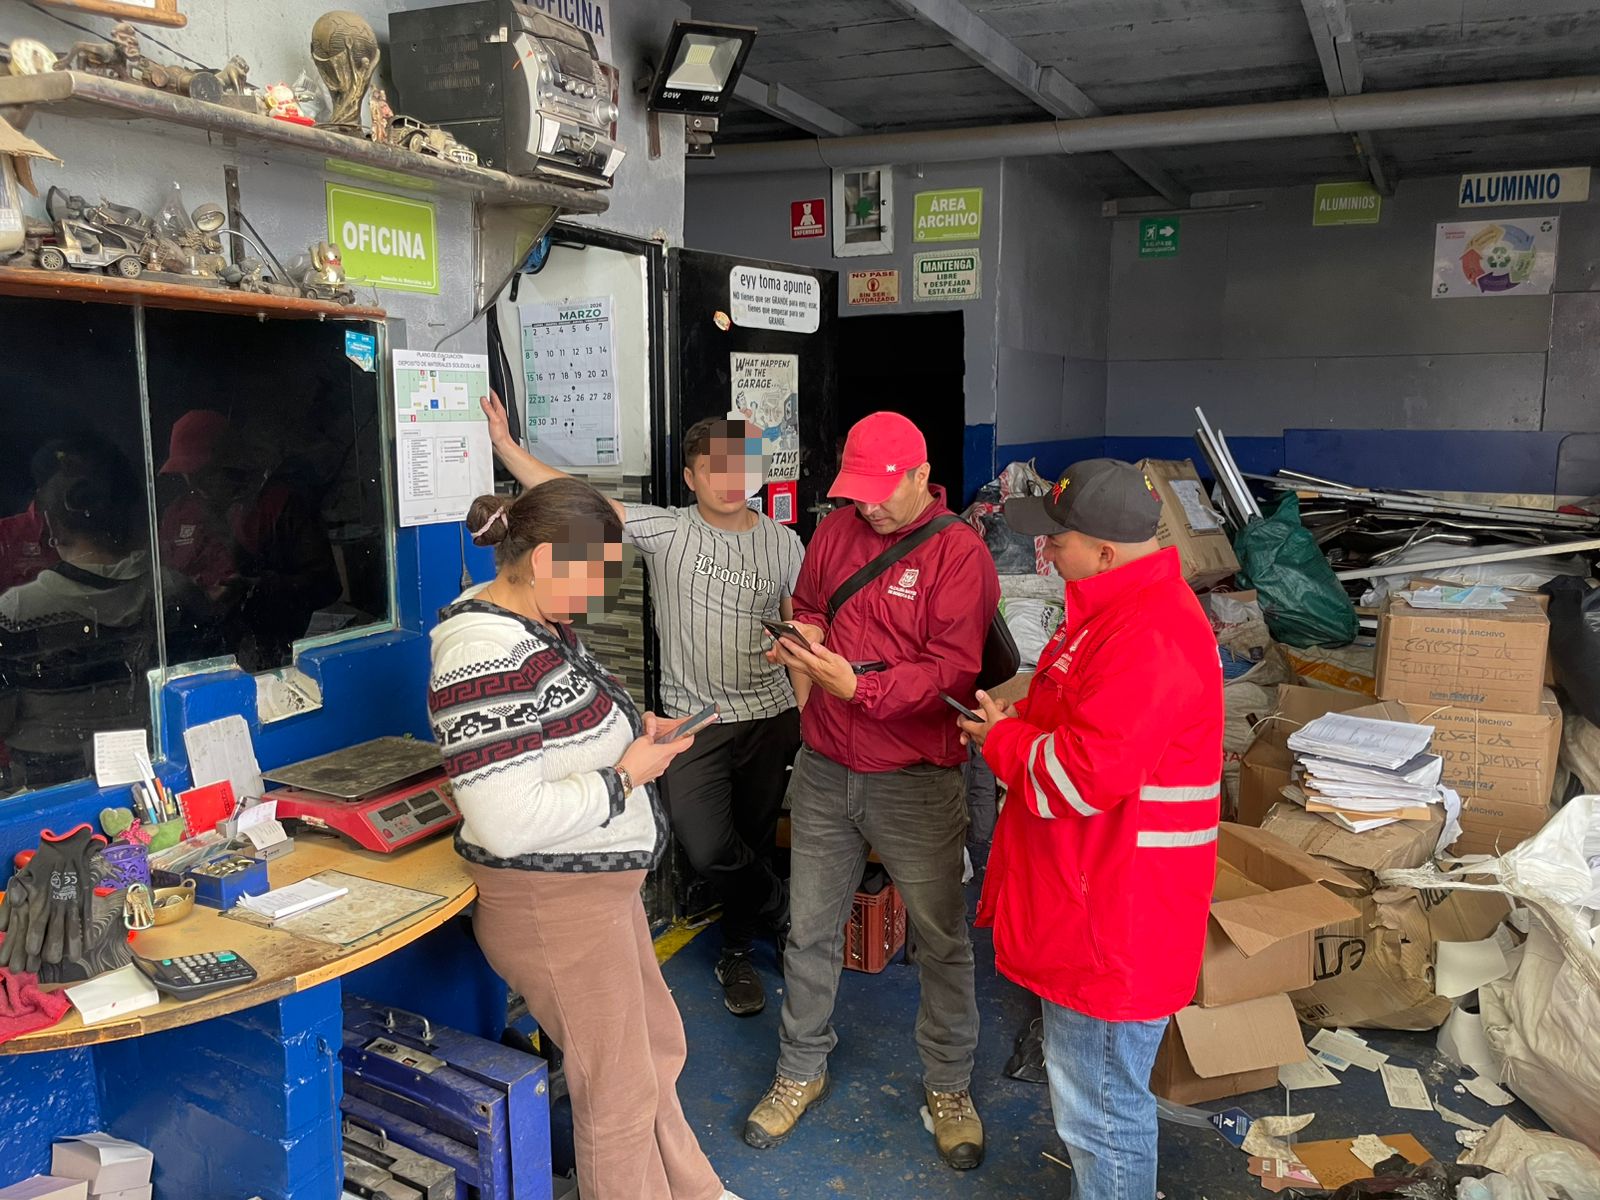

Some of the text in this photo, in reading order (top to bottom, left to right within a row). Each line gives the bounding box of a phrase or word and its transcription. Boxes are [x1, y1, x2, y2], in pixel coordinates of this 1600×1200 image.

[701, 95, 719, 103] IP65
[1461, 173, 1561, 204] ALUMINIO
[930, 196, 966, 212] ÁREA
[1320, 196, 1375, 211] ALUMINIOS
[918, 213, 978, 228] ARCHIVO
[342, 221, 426, 261] OFICINA
[922, 259, 972, 273] MANTENGA
[740, 274, 811, 295] eyy toma apunte
[930, 280, 971, 288] DESPEJADA
[733, 291, 740, 300] NO
[741, 292, 754, 301] tienes
[755, 295, 763, 304] que
[772, 296, 788, 305] GRANDE
[559, 309, 602, 320] MARZO
[748, 304, 761, 313] tienes
[735, 357, 791, 372] WHAT HAPPENS
[744, 368, 766, 377] IN THE
[538, 396, 546, 404] 23
[589, 393, 598, 401] 27
[603, 392, 612, 400] 28
[768, 464, 798, 478] ARAGE!
[692, 553, 776, 596] Brooklyn
[1424, 626, 1445, 634] CAJA
[1469, 629, 1505, 638] ARCHIVO
[1477, 718, 1513, 727] ARCHIVO
[1468, 806, 1504, 817] ARCHIVO
